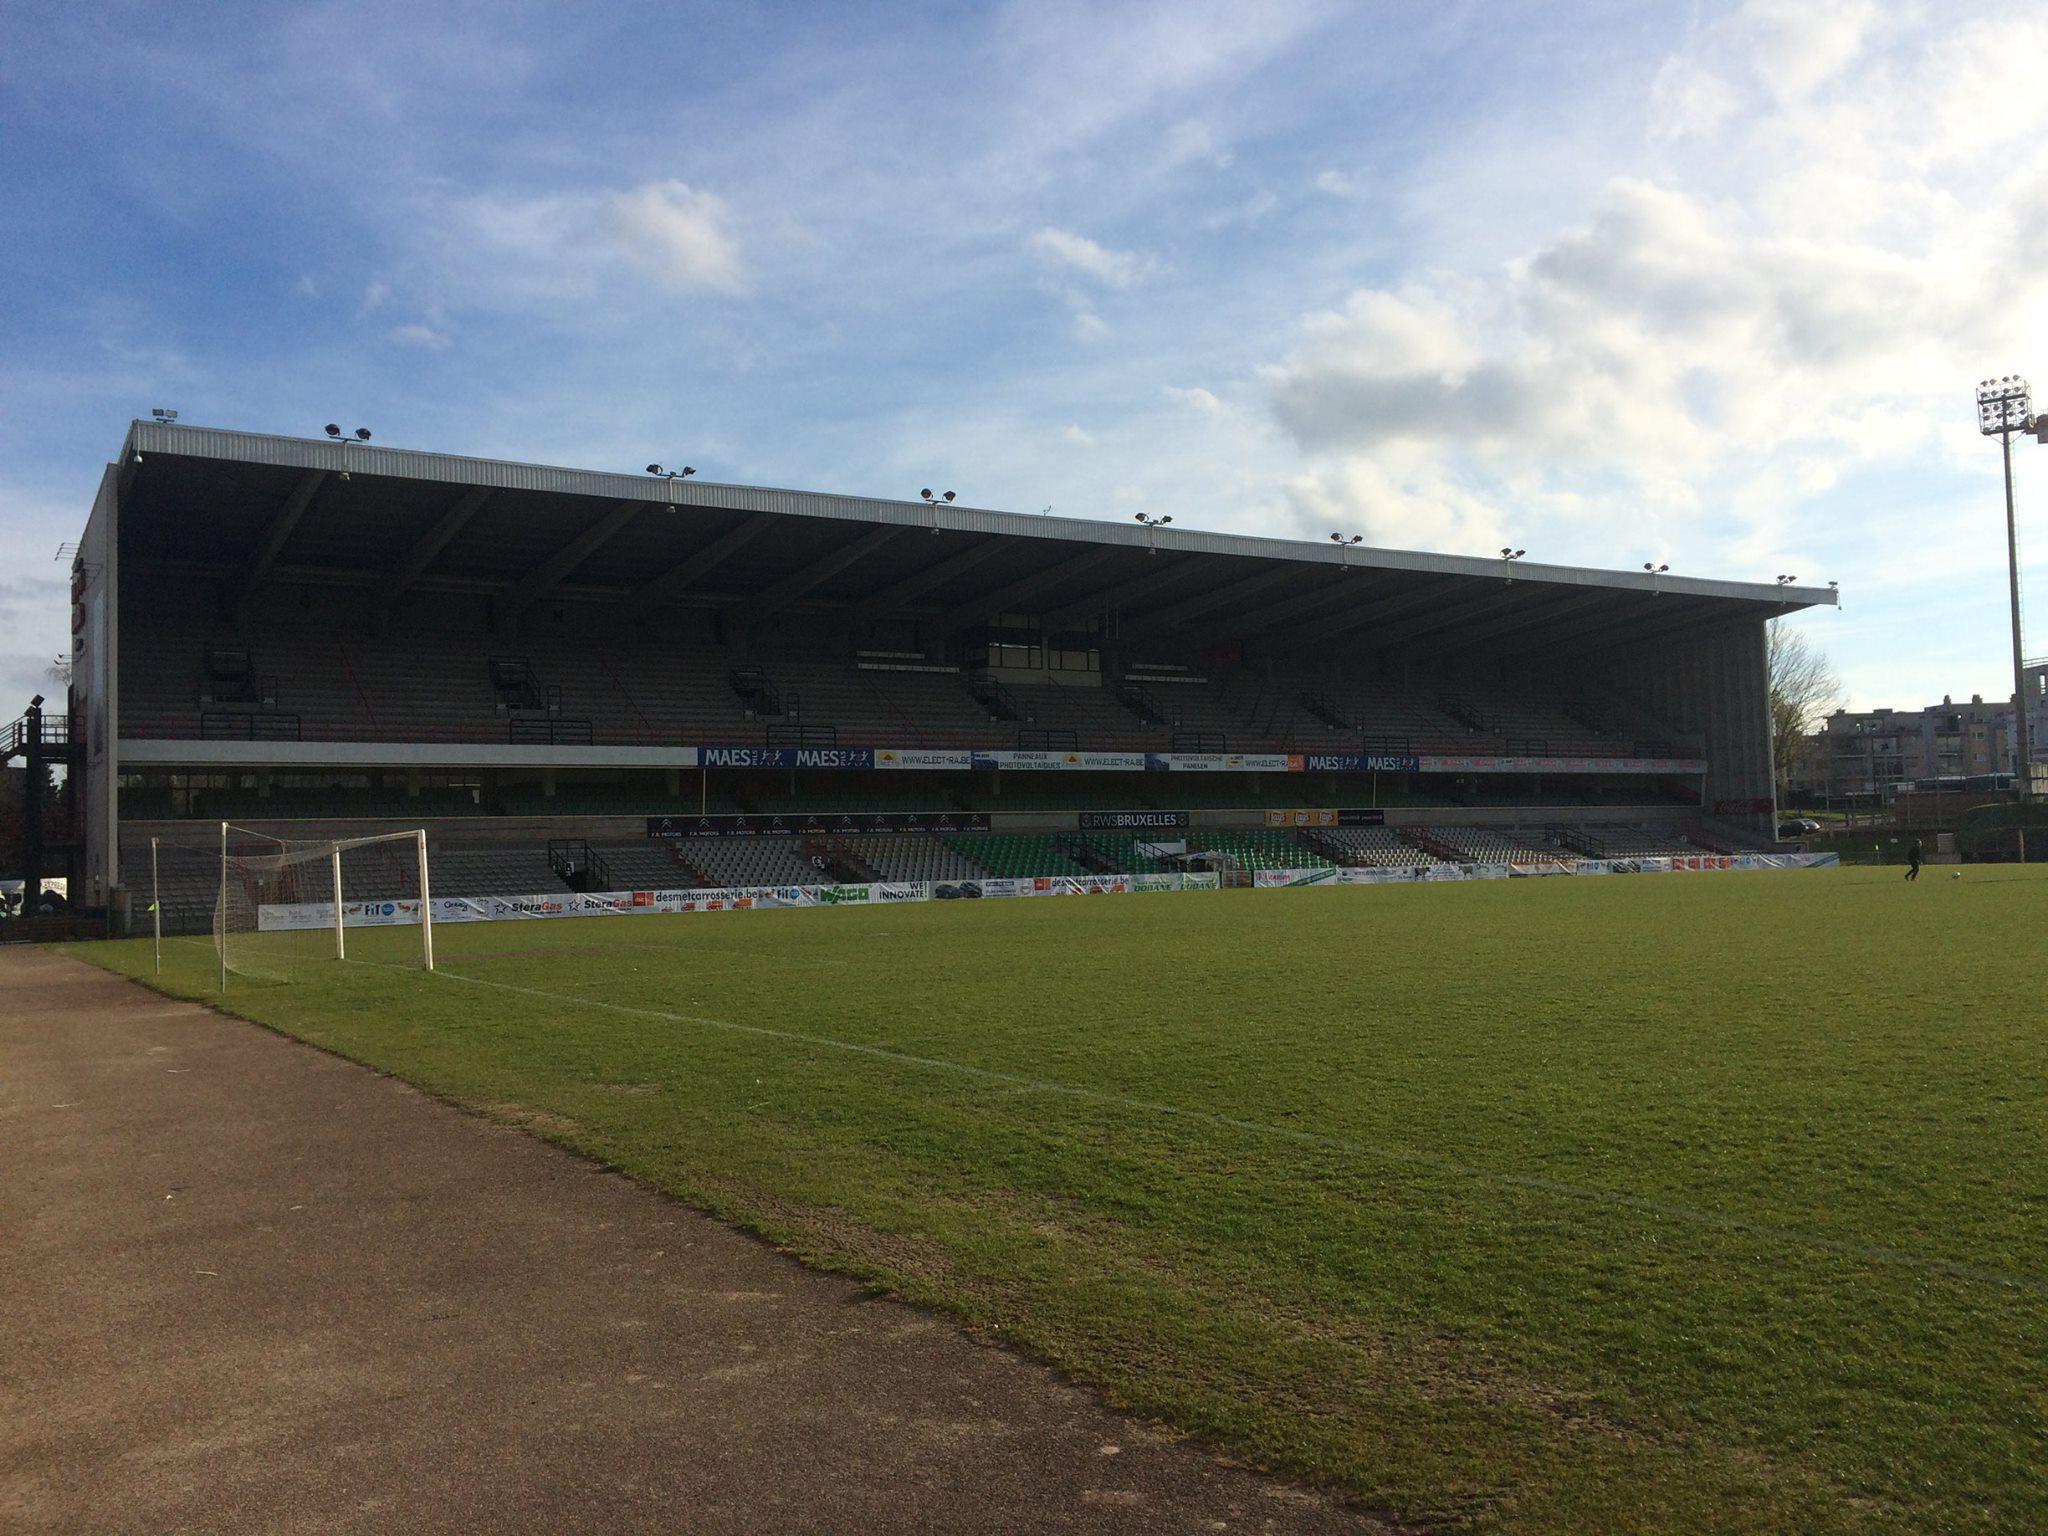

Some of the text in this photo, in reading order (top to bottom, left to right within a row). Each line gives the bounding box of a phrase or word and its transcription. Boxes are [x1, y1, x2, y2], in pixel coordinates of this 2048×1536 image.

[705, 749, 751, 766] MAES
[796, 750, 839, 766] MAES
[1309, 756, 1339, 770] MAES
[1367, 757, 1396, 770] MAES
[656, 888, 757, 902] desmetcarrosserie.be
